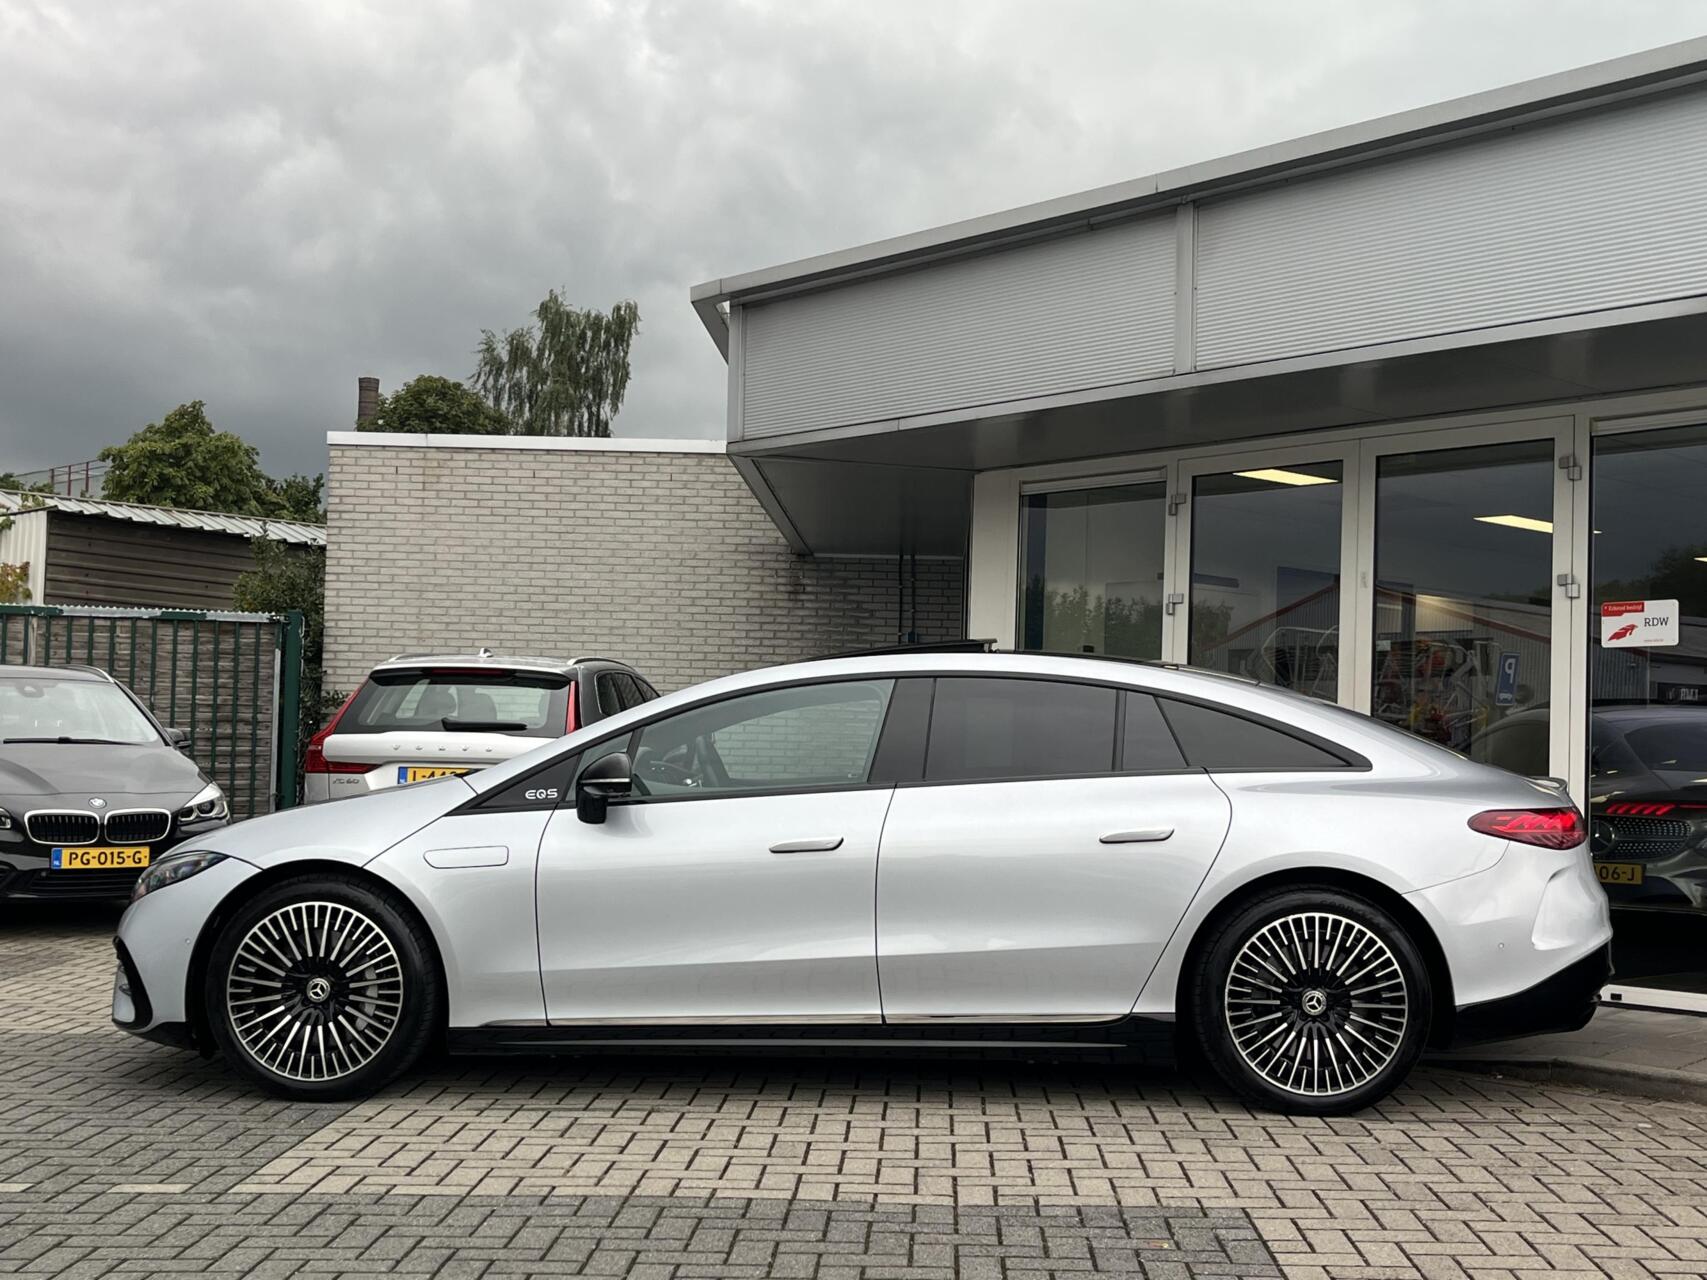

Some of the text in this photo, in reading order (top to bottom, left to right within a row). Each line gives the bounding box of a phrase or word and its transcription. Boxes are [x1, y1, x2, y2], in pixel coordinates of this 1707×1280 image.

[1644, 616, 1669, 627] RDW
[525, 788, 558, 800] EQS
[68, 851, 142, 866] PG-015-G
[1594, 865, 1635, 881] 06-J
